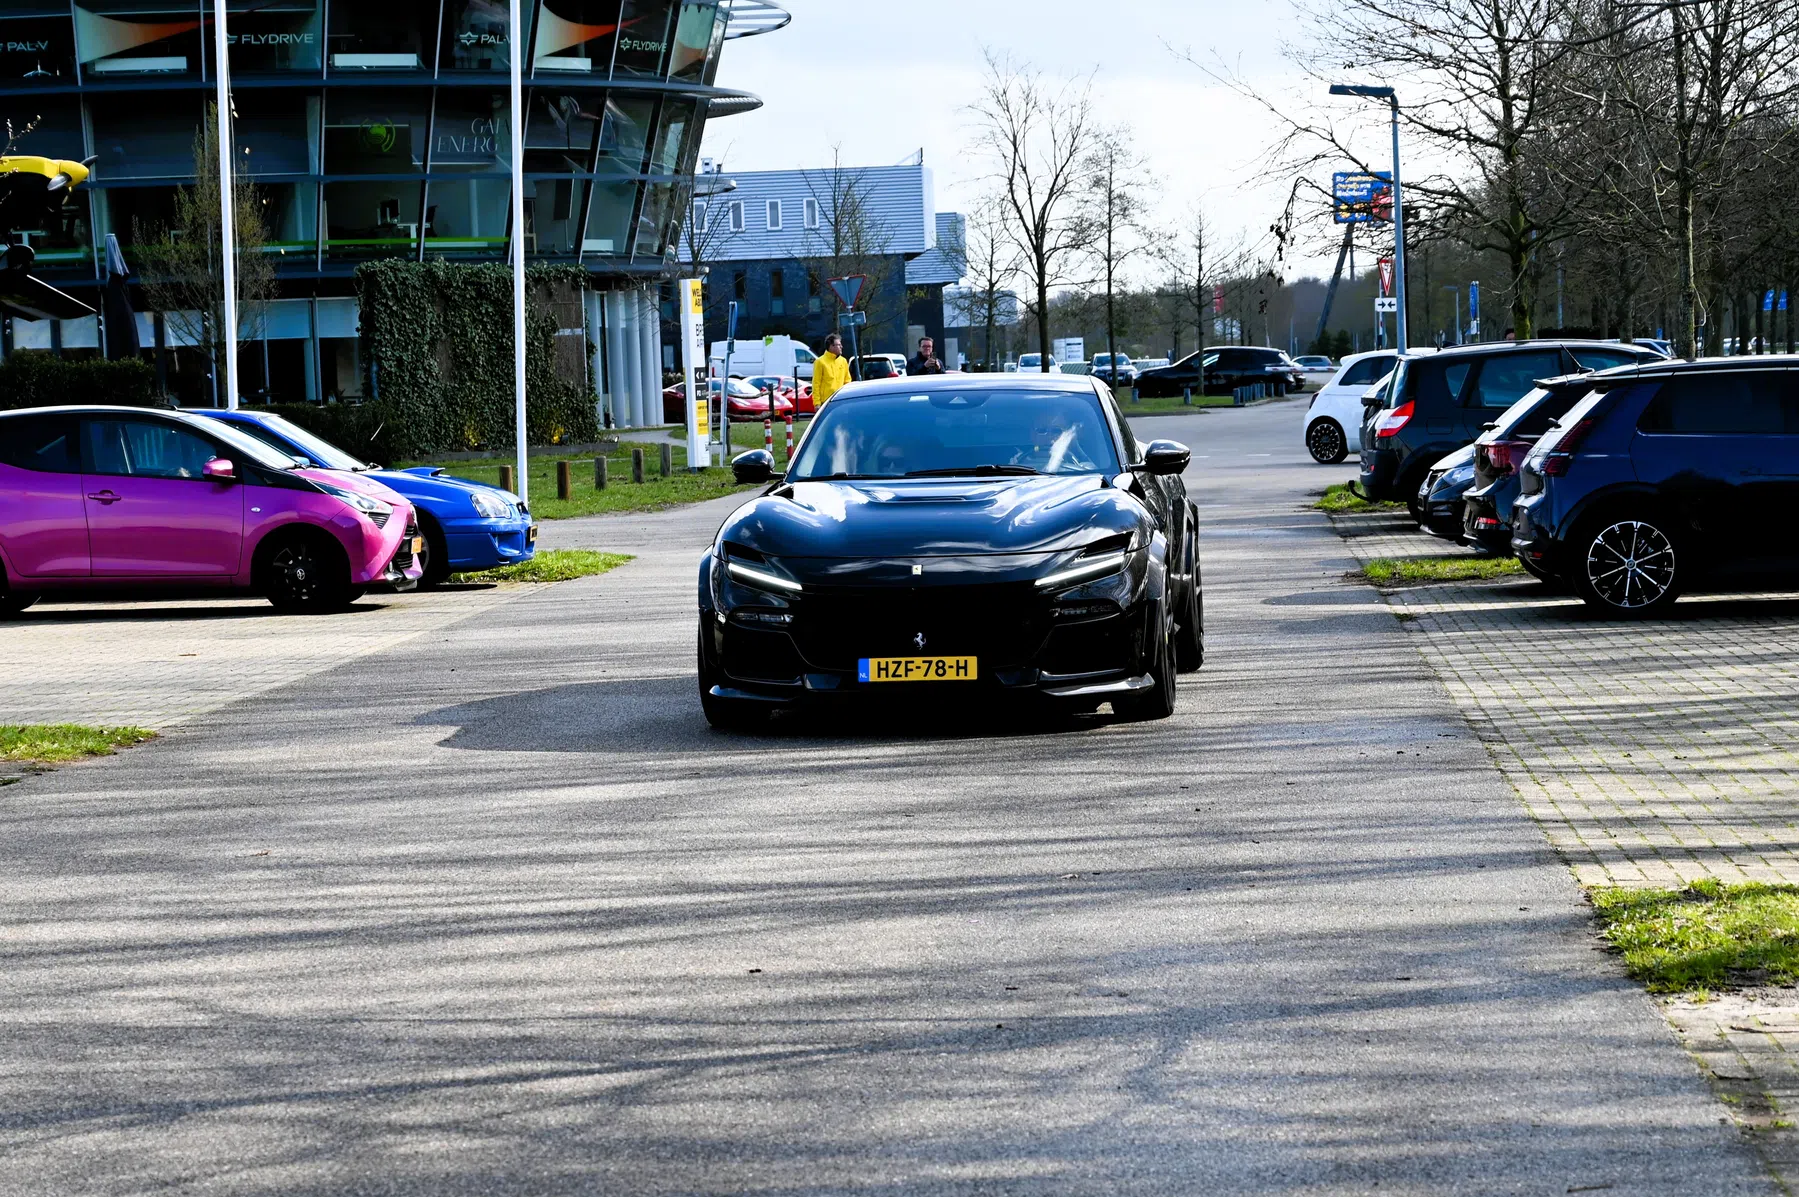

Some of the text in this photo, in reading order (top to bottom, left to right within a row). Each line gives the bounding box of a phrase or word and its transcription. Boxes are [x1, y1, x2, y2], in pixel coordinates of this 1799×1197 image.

[241, 33, 314, 44] FLYDRIVE
[632, 40, 667, 52] FLYDRIVE
[437, 135, 504, 153] ENERG
[877, 659, 968, 678] HZF-78-H
